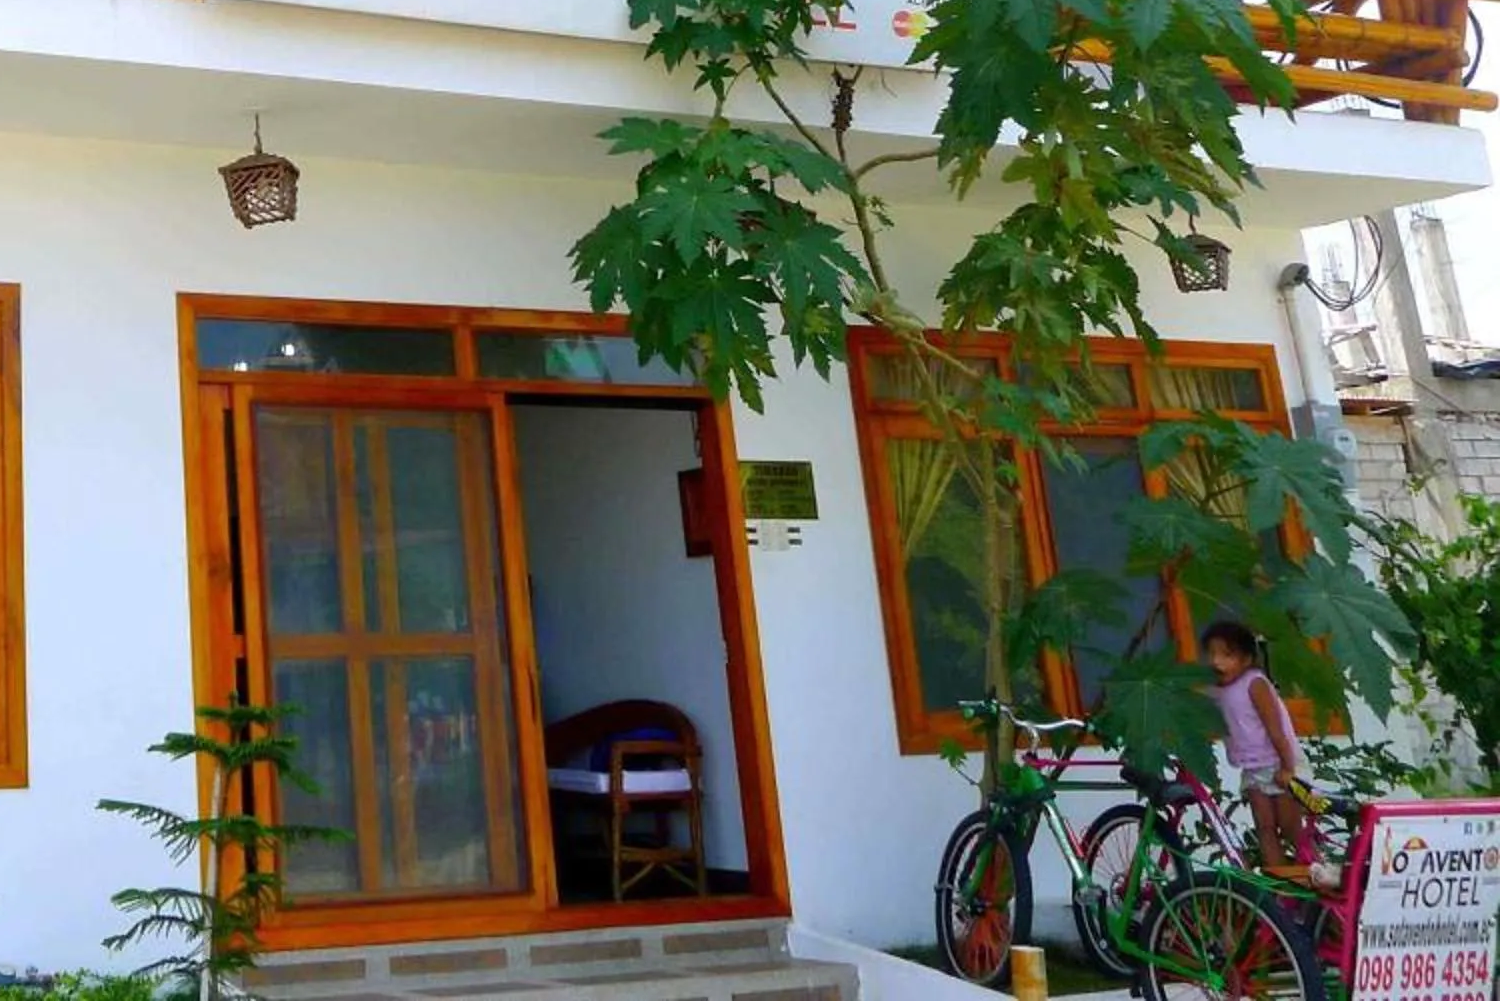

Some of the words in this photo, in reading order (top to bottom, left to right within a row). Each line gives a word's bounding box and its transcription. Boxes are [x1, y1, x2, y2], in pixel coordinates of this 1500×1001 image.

[1401, 877, 1480, 908] HOTEL
[1359, 955, 1395, 992] 098
[1400, 952, 1437, 989] 986
[1441, 950, 1489, 987] 4354
